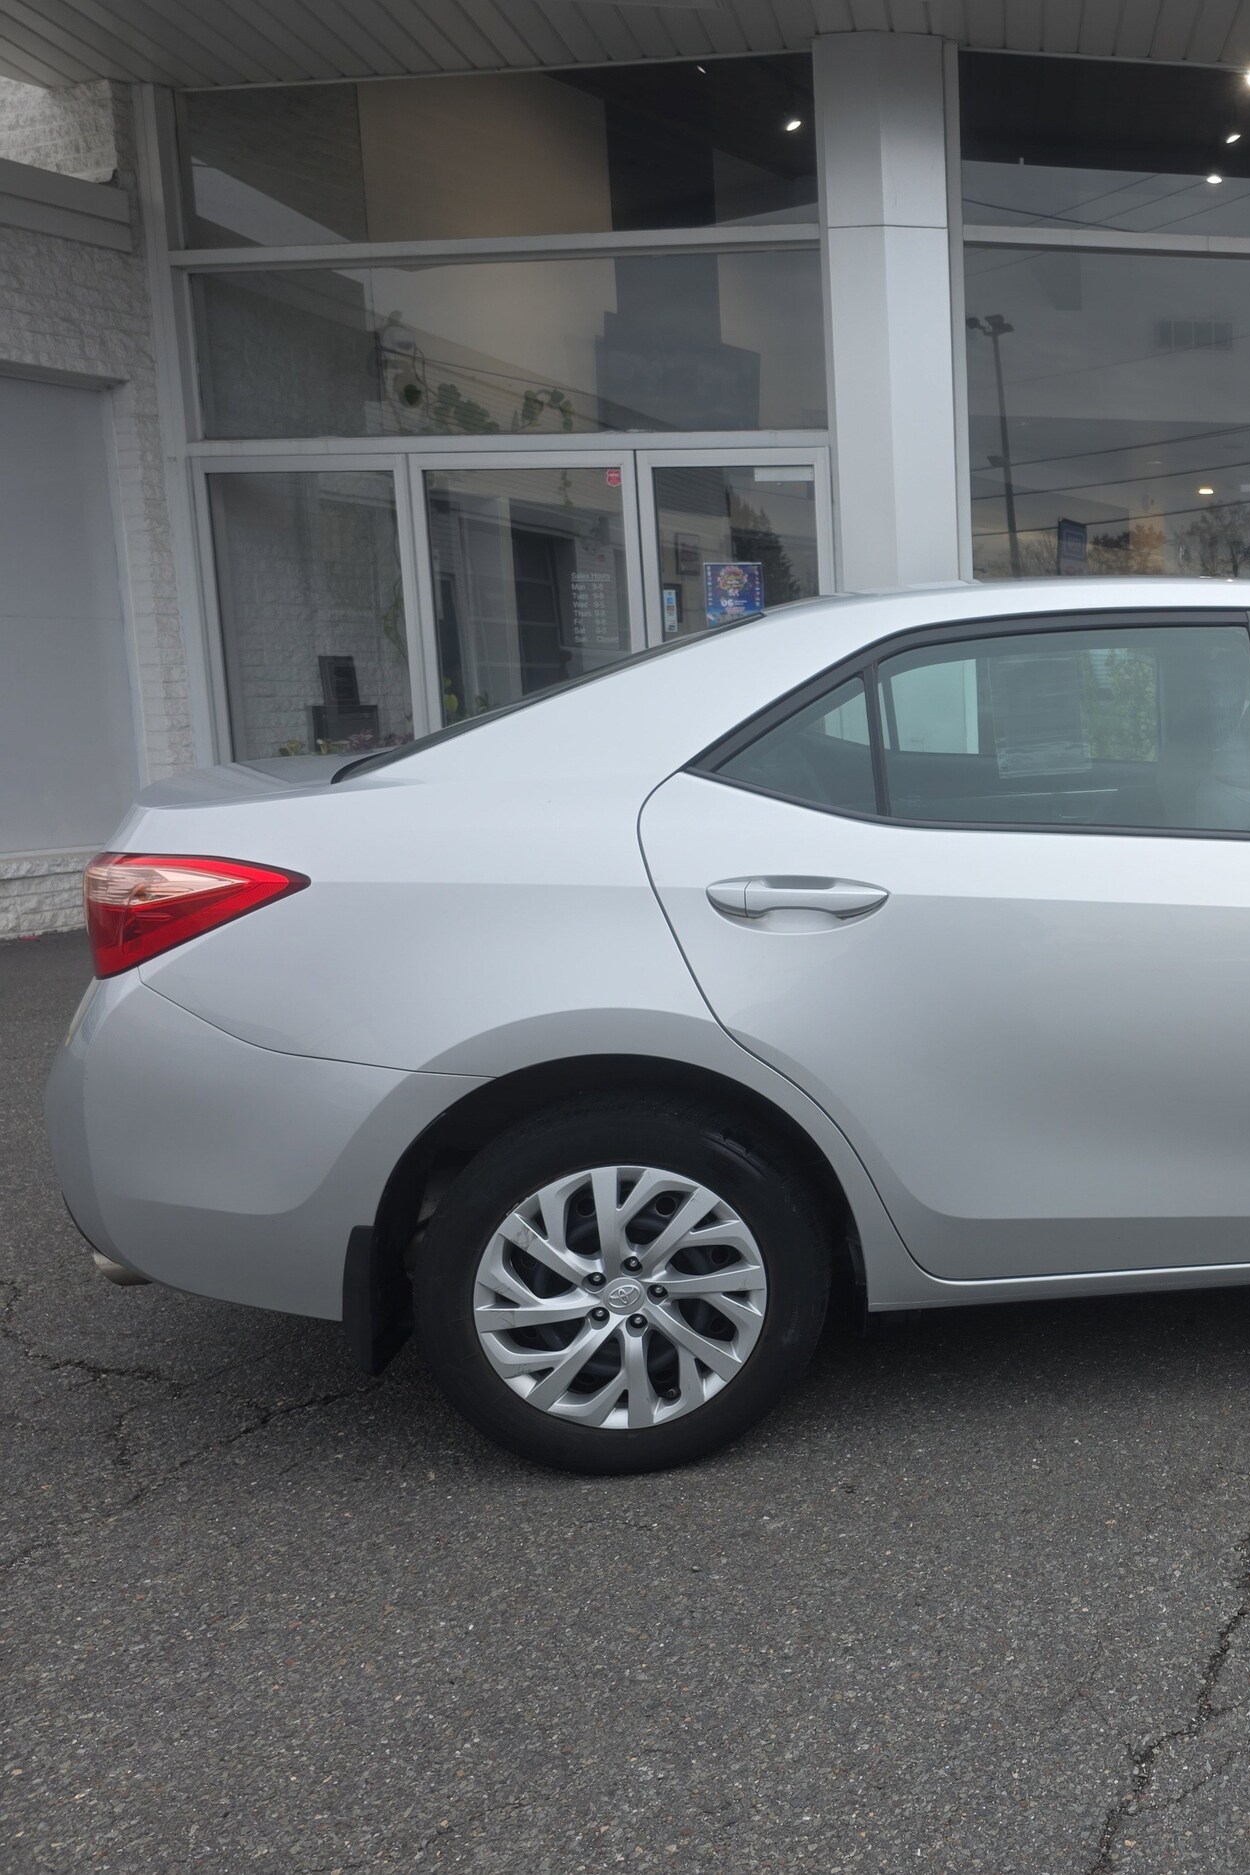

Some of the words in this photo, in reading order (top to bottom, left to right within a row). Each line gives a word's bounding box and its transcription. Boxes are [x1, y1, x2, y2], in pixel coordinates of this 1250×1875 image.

[571, 572, 590, 580] Sales
[591, 572, 611, 580] Hours
[571, 583, 586, 591] Mon
[572, 592, 589, 600] Tues
[573, 600, 589, 609] Wed
[574, 609, 592, 618] Thurs
[574, 618, 583, 626] Fri
[574, 627, 586, 635] Sat
[574, 635, 588, 643] Sun
[596, 635, 619, 644] Closed
